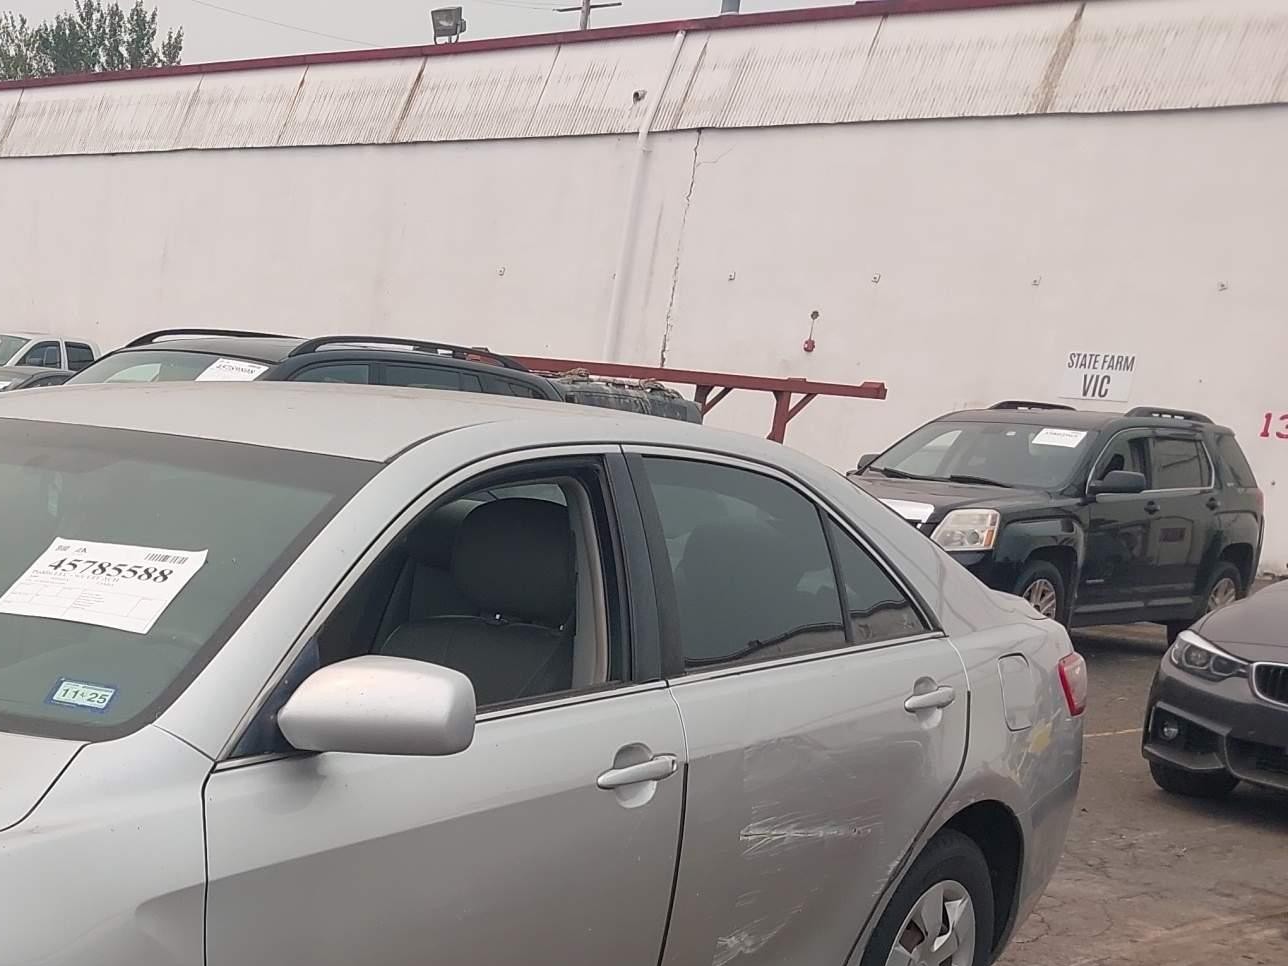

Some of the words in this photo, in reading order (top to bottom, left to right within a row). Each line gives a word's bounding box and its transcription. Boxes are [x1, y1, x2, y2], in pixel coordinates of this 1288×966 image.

[1067, 352, 1100, 370] STATE
[1101, 354, 1136, 372] FARM
[1082, 374, 1111, 398] VIC
[48, 557, 174, 583] 45785588
